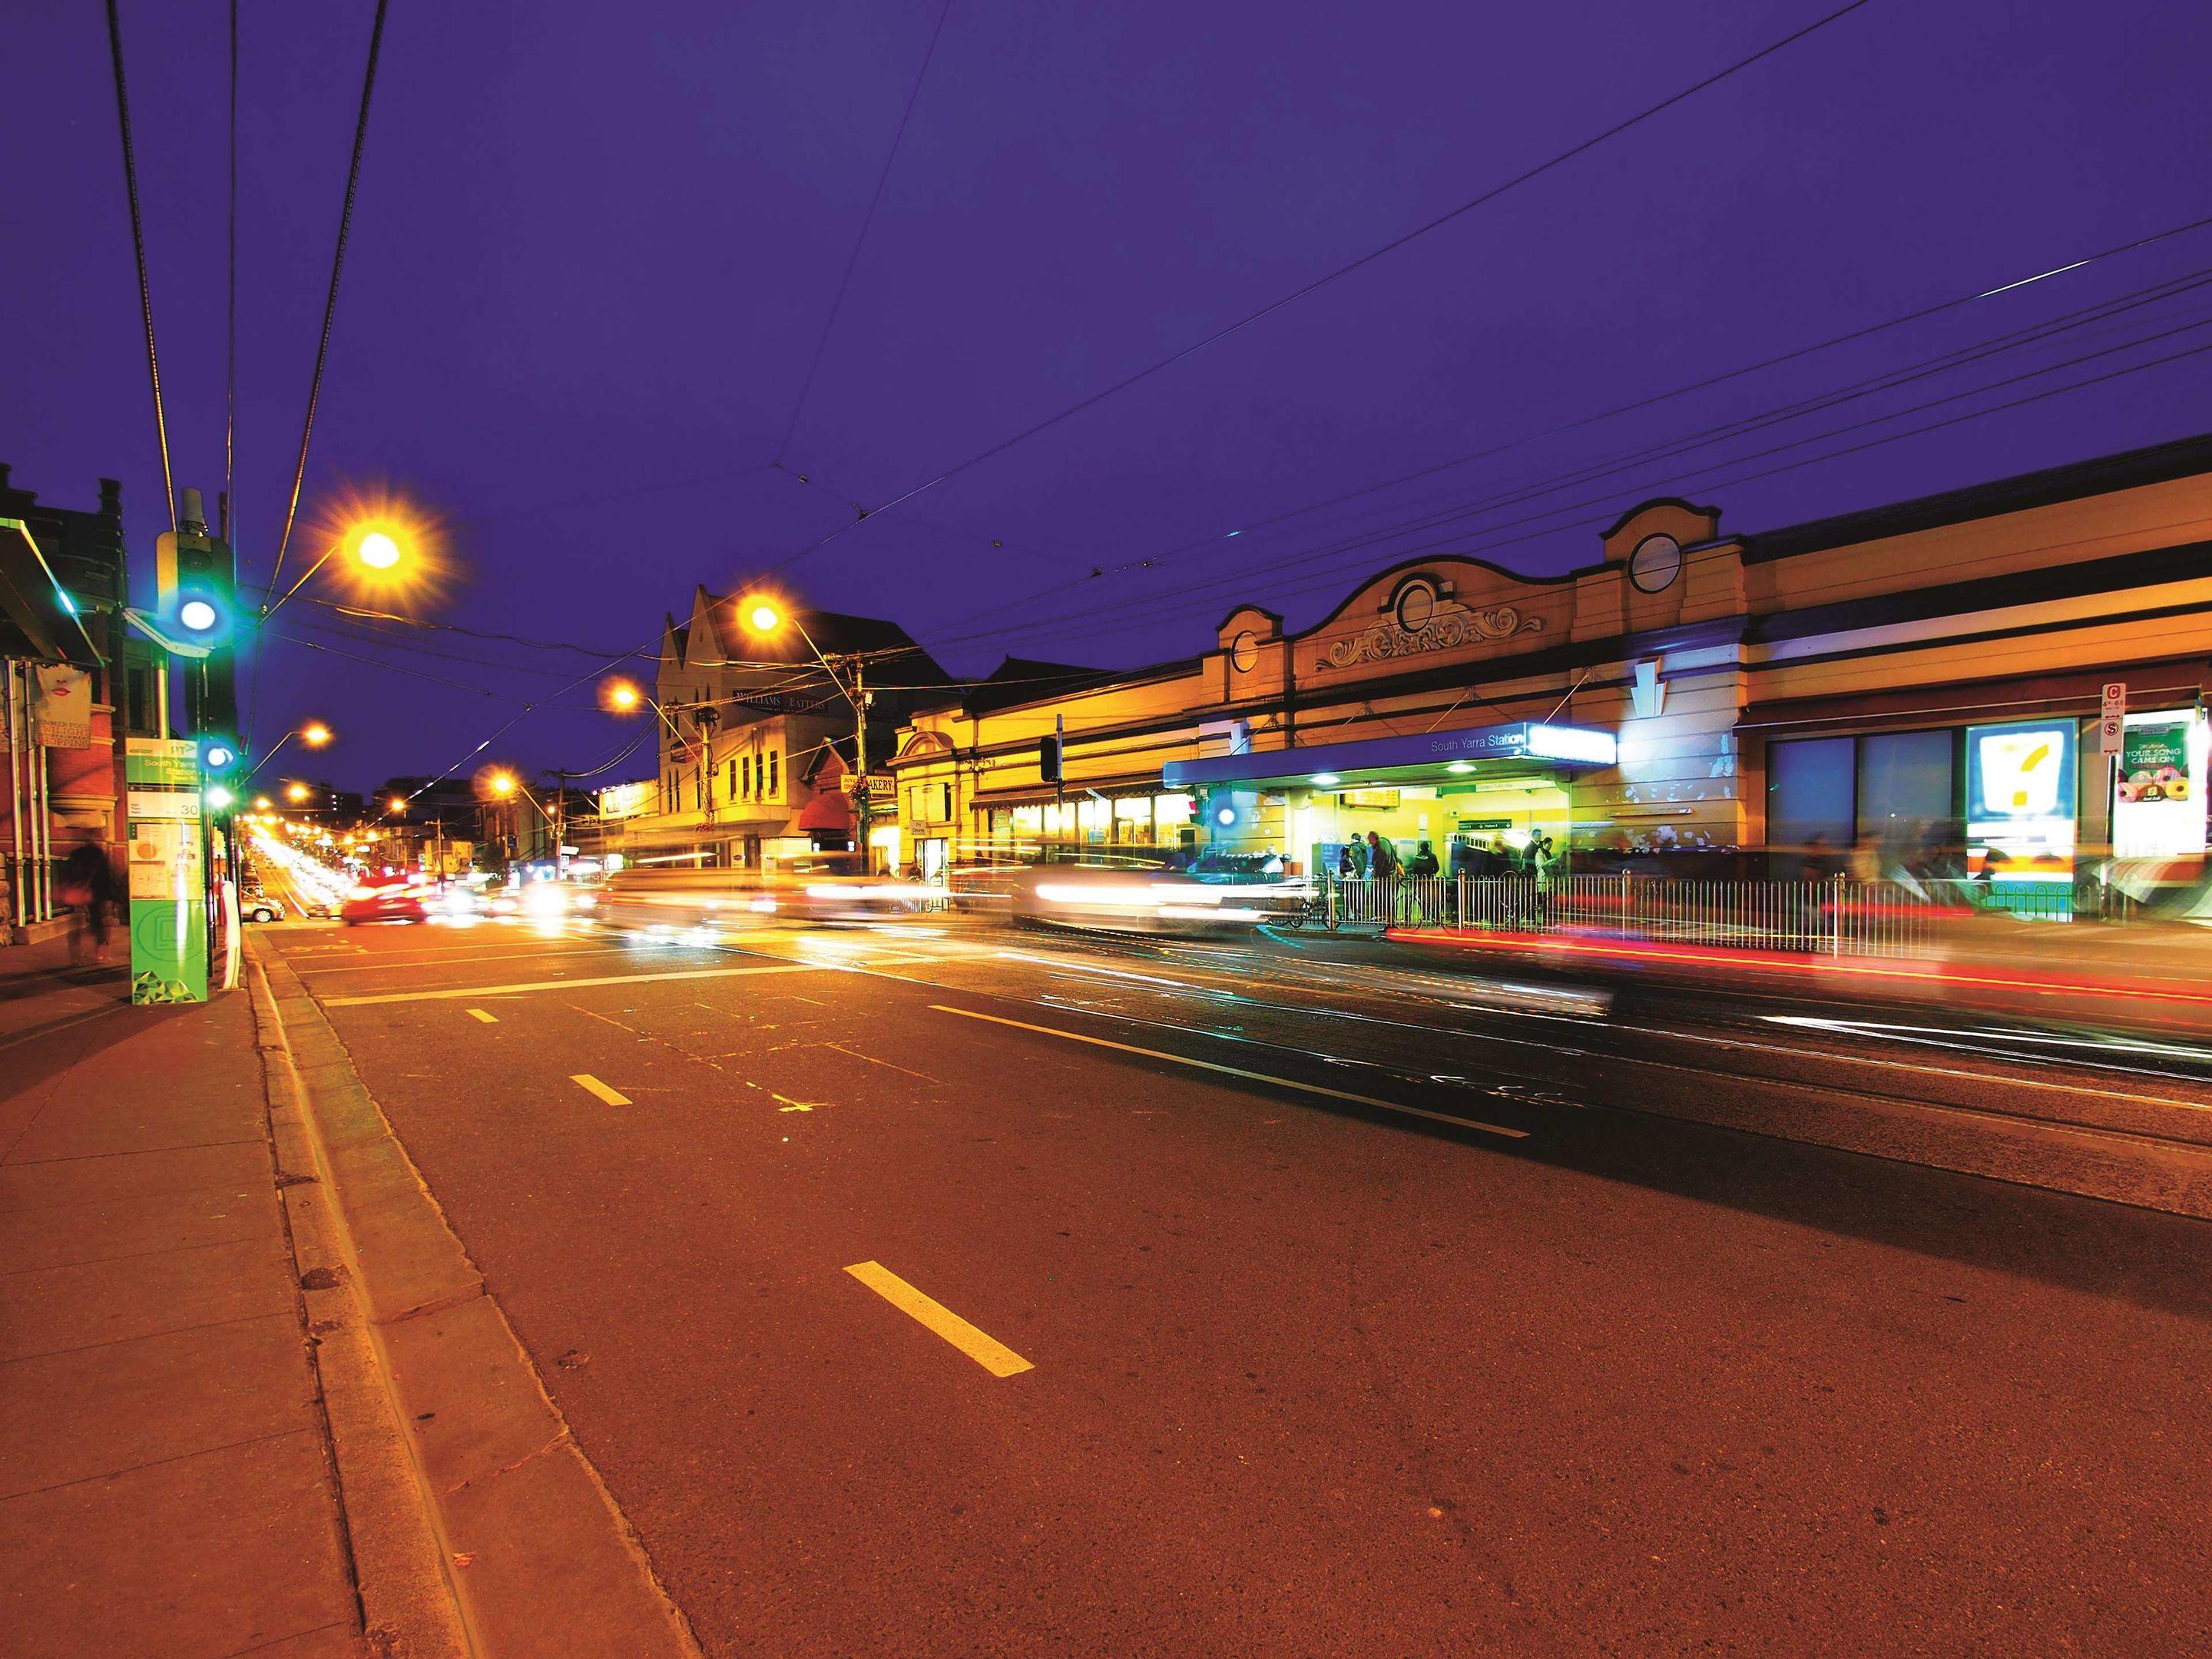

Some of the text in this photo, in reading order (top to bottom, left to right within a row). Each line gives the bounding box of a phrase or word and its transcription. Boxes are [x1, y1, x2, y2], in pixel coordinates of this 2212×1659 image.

[2109, 687, 2118, 697] C
[737, 691, 781, 706] WILLIAMS
[2107, 724, 2116, 733] S
[1431, 733, 1525, 752] South Yarra Station
[166, 767, 197, 776] Station
[869, 779, 892, 791] AKERY
[180, 804, 198, 815] 30
